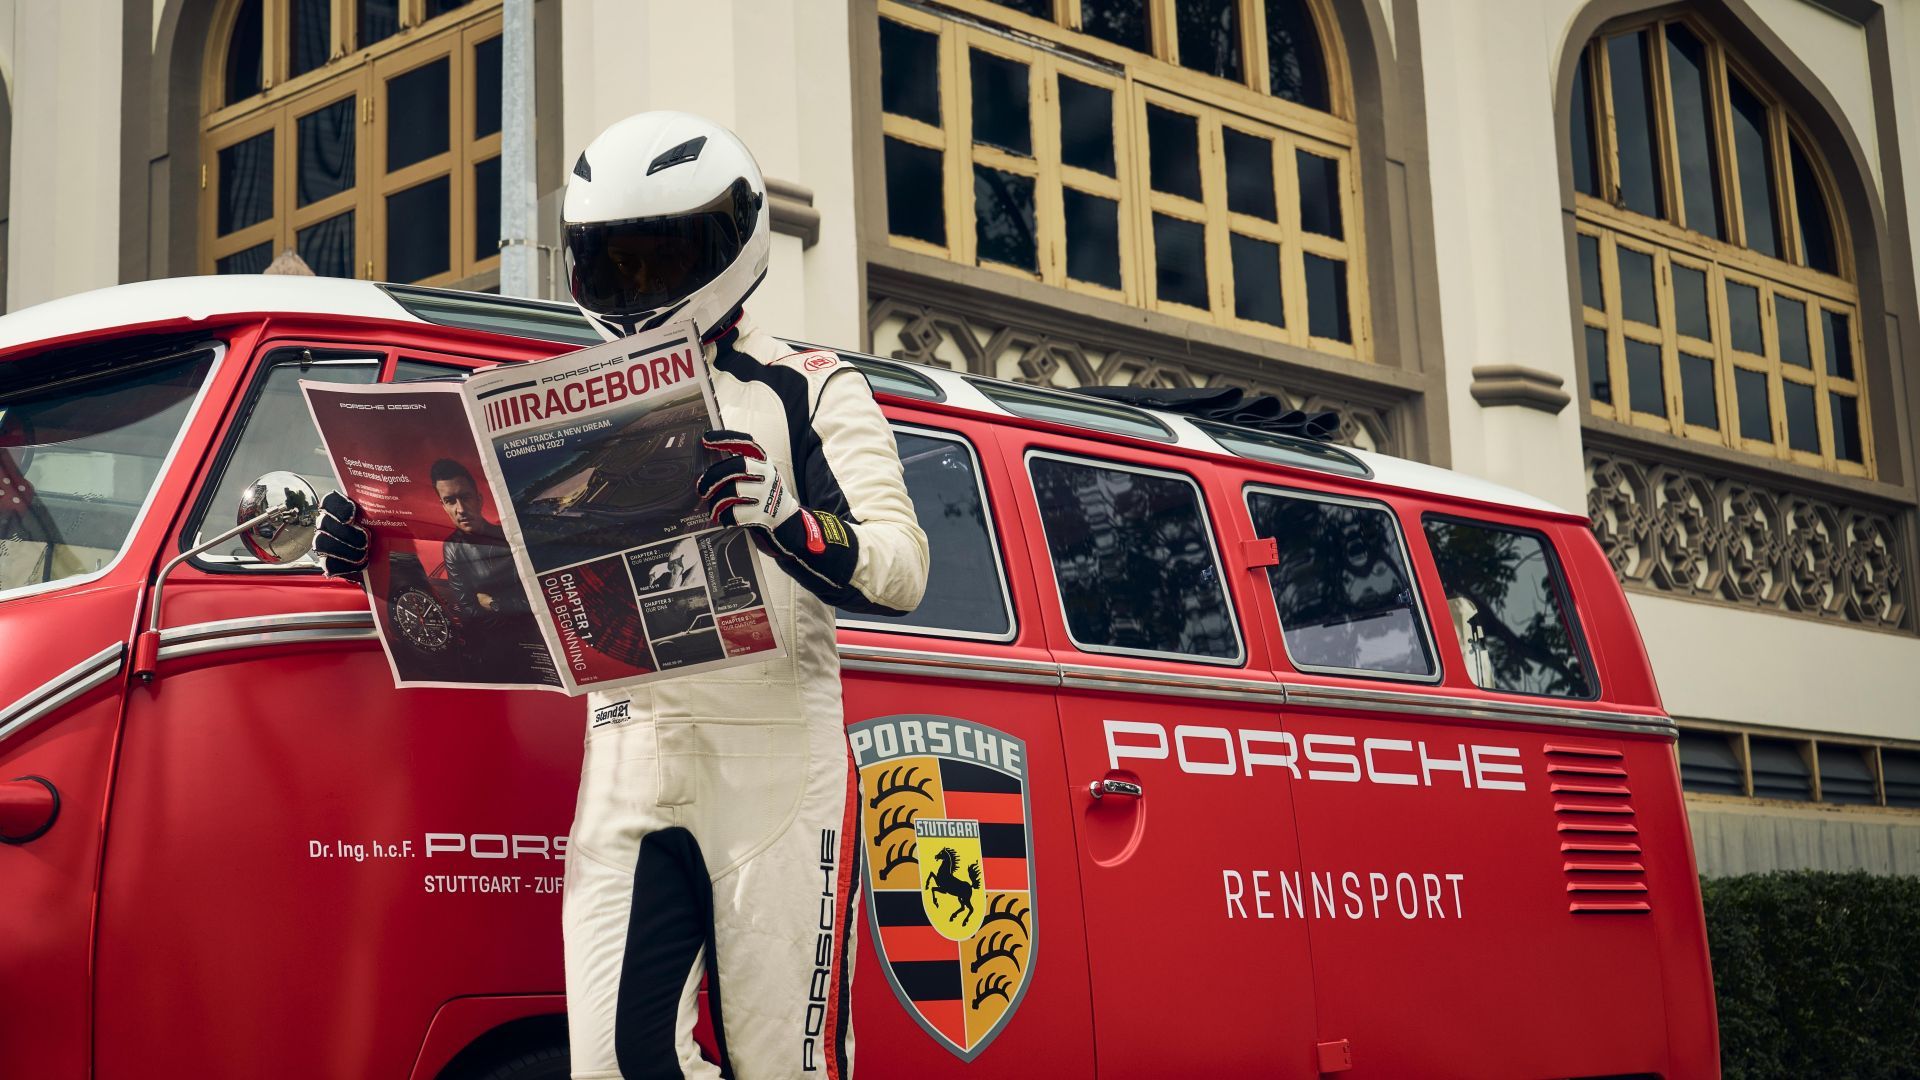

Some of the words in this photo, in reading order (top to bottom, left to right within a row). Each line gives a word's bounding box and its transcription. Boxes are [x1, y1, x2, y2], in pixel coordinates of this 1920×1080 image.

[541, 356, 625, 384] PORSCHE
[520, 348, 695, 422] RACEBORN
[340, 402, 385, 410] PORSCHE
[503, 442, 510, 450] A
[510, 436, 529, 448] NEW
[528, 432, 557, 444] TRACK.
[562, 425, 582, 437] NEW
[582, 419, 613, 432] DREAM.
[505, 444, 536, 459] COMING
[537, 443, 546, 451] IN
[546, 439, 566, 450] 2027
[344, 456, 362, 468] Speed
[362, 460, 375, 470] wins
[374, 464, 395, 472] races.
[348, 467, 364, 476] Time
[382, 474, 411, 485] legends.
[630, 552, 654, 560] CHAPTER
[561, 574, 589, 630] CHAPTER
[644, 598, 668, 608] CHAPTER
[545, 578, 564, 603] OUR
[555, 605, 586, 671] BEGINNING
[596, 704, 628, 722] stand21
[848, 720, 1022, 776] PORSCHE
[1103, 720, 1527, 792] PORSCHE
[916, 820, 978, 838] STUTTGART
[309, 840, 334, 858] Dr.
[338, 840, 368, 862] Ing.
[424, 874, 521, 892] STUTTGART
[534, 876, 564, 894] ZUF
[1222, 869, 1464, 920] RENNSPORT
[803, 828, 836, 1072] PORSCHE
